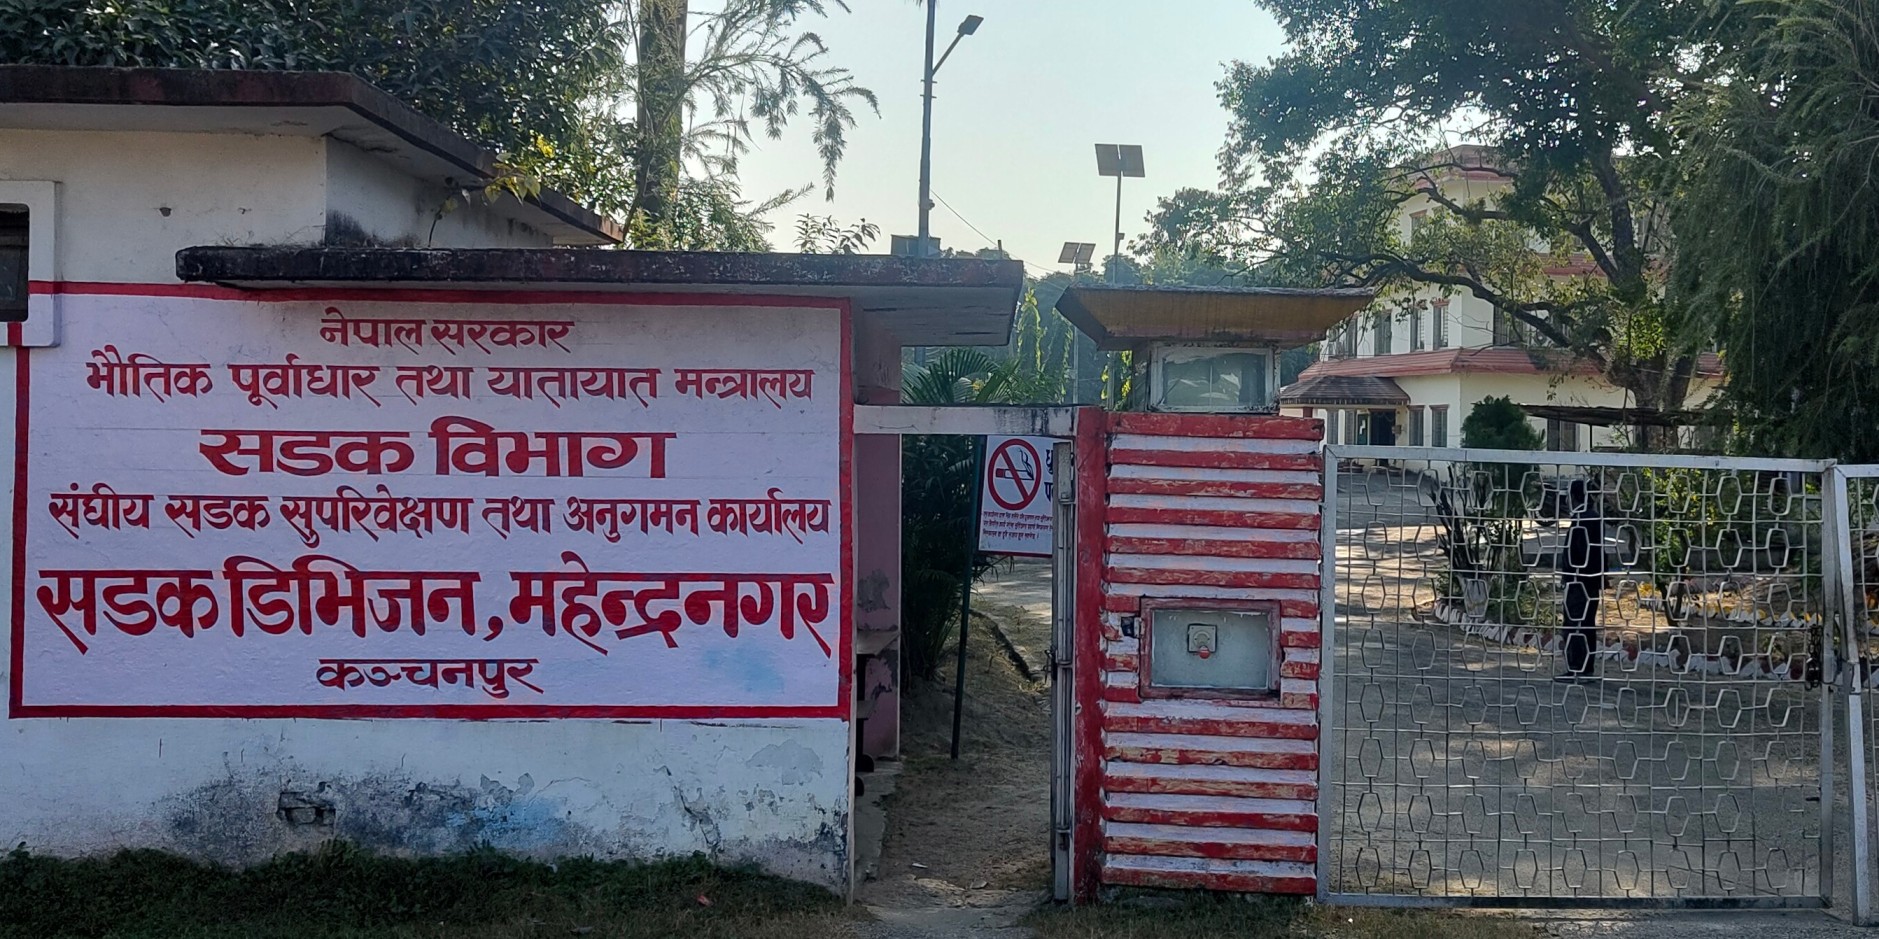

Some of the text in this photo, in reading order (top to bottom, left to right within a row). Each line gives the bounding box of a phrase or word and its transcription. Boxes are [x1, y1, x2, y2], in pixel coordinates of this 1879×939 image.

[320, 307, 575, 354] नेपाल सरकार
[86, 344, 815, 410] भौतिक पूर्वाधार तथा यातायात मन्त्रालय
[199, 415, 677, 479] सडक विभाग
[48, 483, 831, 548] संघीय सडक सुपरिवेक्षण तथा अनुगमन कार्यालय
[36, 570, 219, 655] सडक
[509, 550, 834, 659] महेन्द्रनगर
[316, 658, 544, 699] कञ्चनपुर
